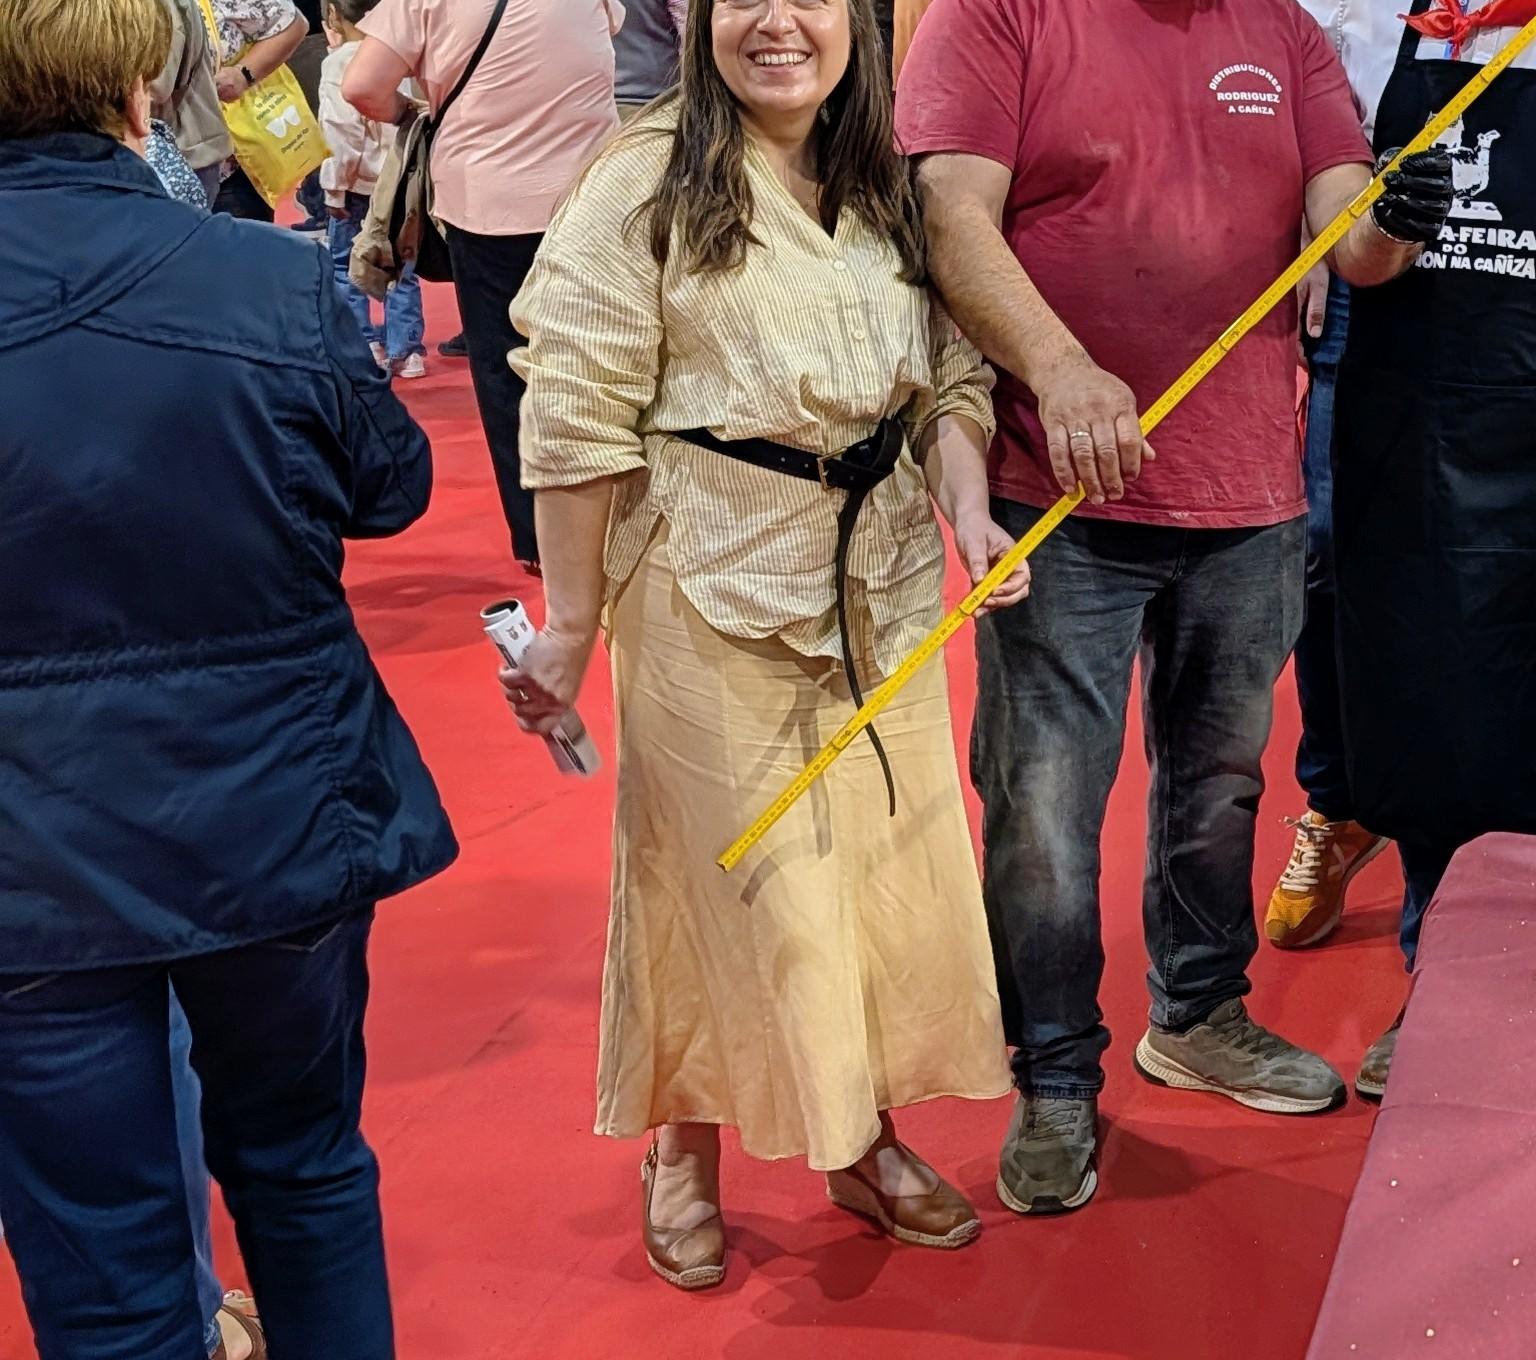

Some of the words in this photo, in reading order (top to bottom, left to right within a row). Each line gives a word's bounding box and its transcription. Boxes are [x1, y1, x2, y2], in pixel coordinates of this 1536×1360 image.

[1209, 63, 1282, 93] DISTRIBUCIONES
[1216, 91, 1280, 103] RODRIGUEZ
[1228, 105, 1236, 114] A
[1238, 104, 1275, 116] CAÑIZA
[1442, 243, 1468, 255] DO
[1450, 256, 1472, 270] NA
[1474, 253, 1536, 280] CAÑIZA
